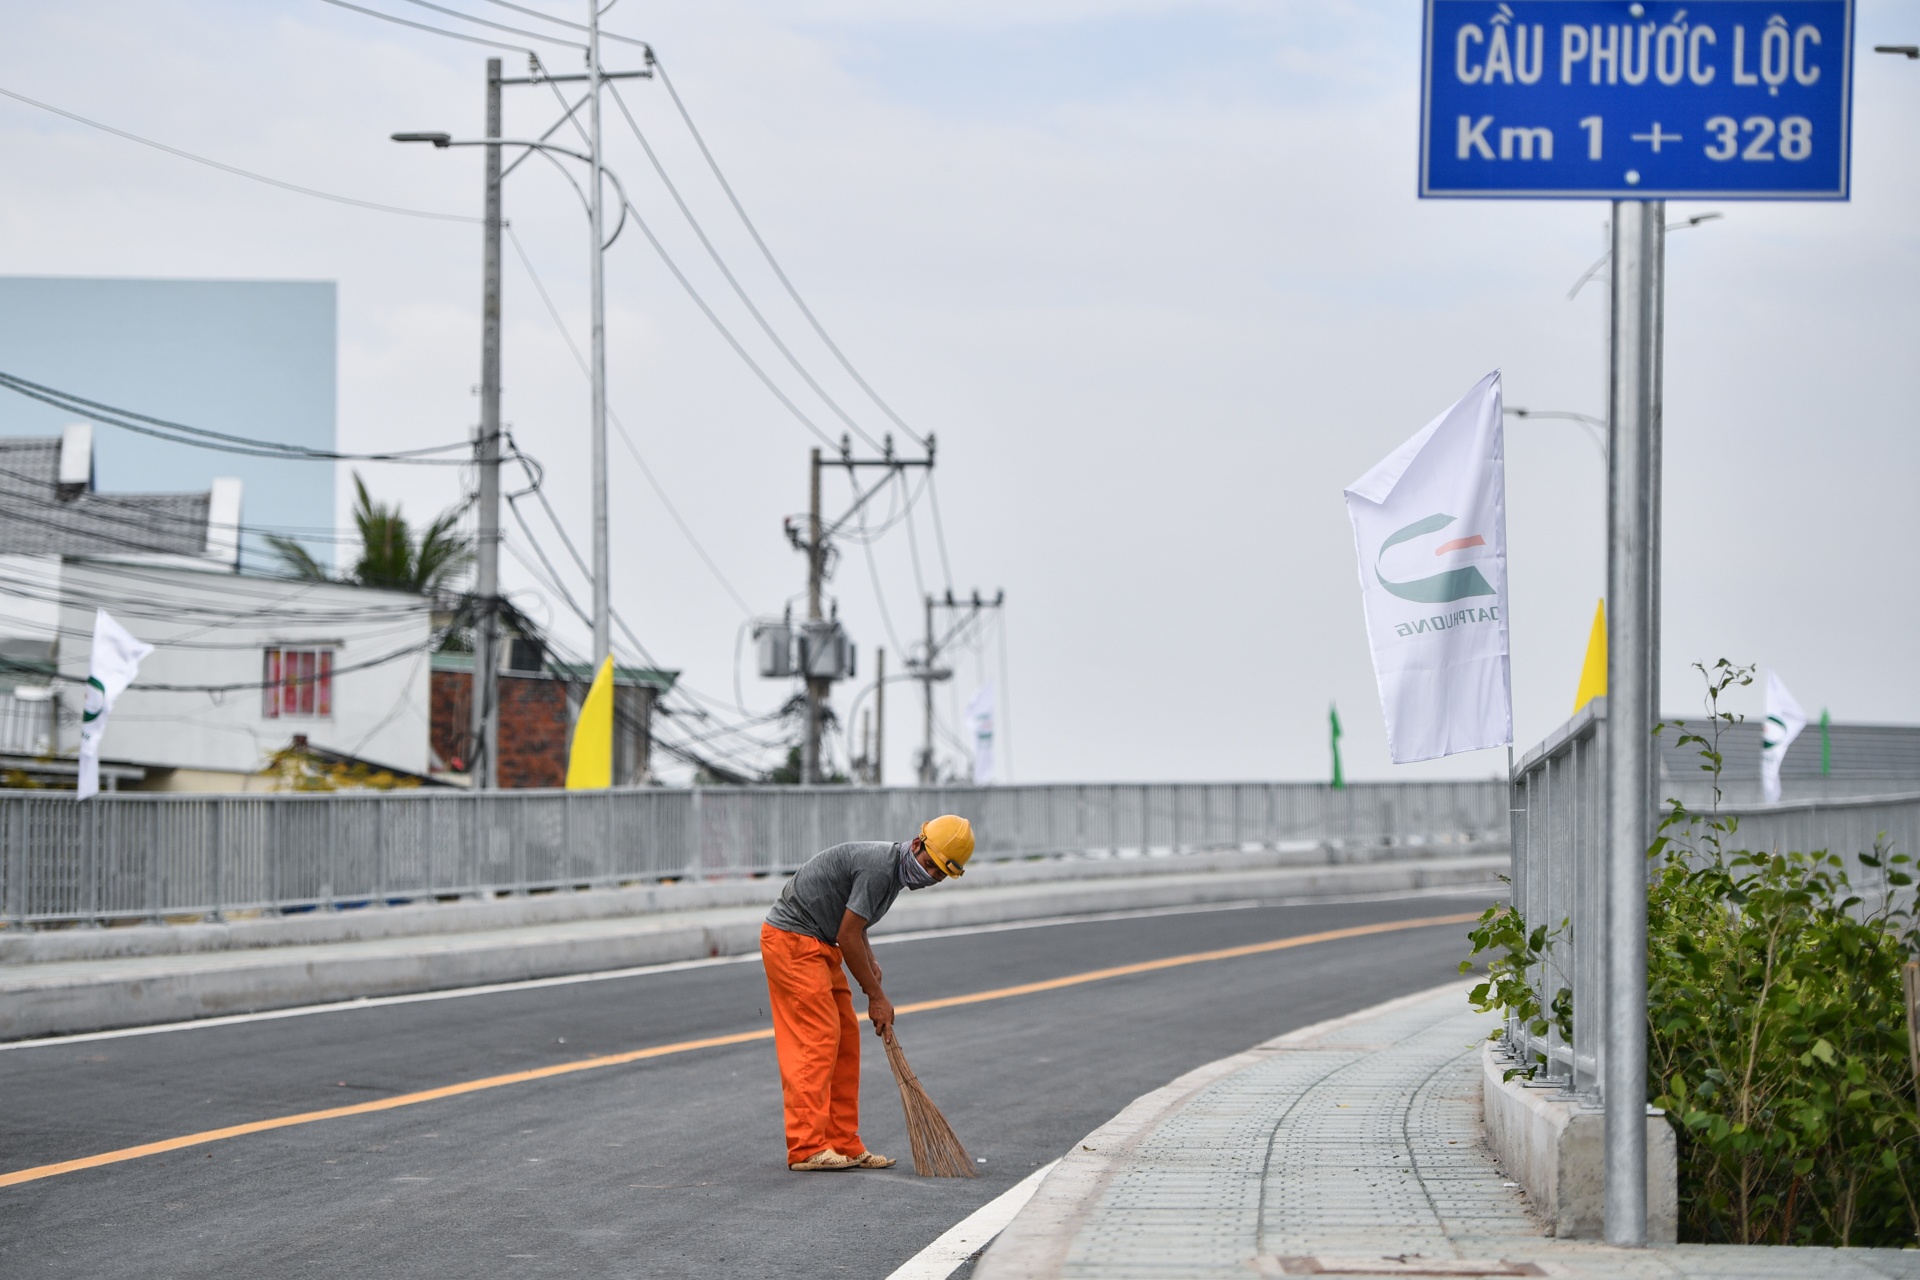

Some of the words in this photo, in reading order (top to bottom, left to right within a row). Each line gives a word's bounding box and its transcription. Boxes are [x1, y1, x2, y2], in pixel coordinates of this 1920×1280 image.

[1455, 4, 1544, 86] CẦU
[1560, 10, 1717, 86] PHƯỚC
[1732, 14, 1821, 97] LỘC
[1456, 114, 1555, 161] Km
[1579, 116, 1603, 161] 1
[1630, 121, 1683, 154] +
[1703, 115, 1813, 162] 328
